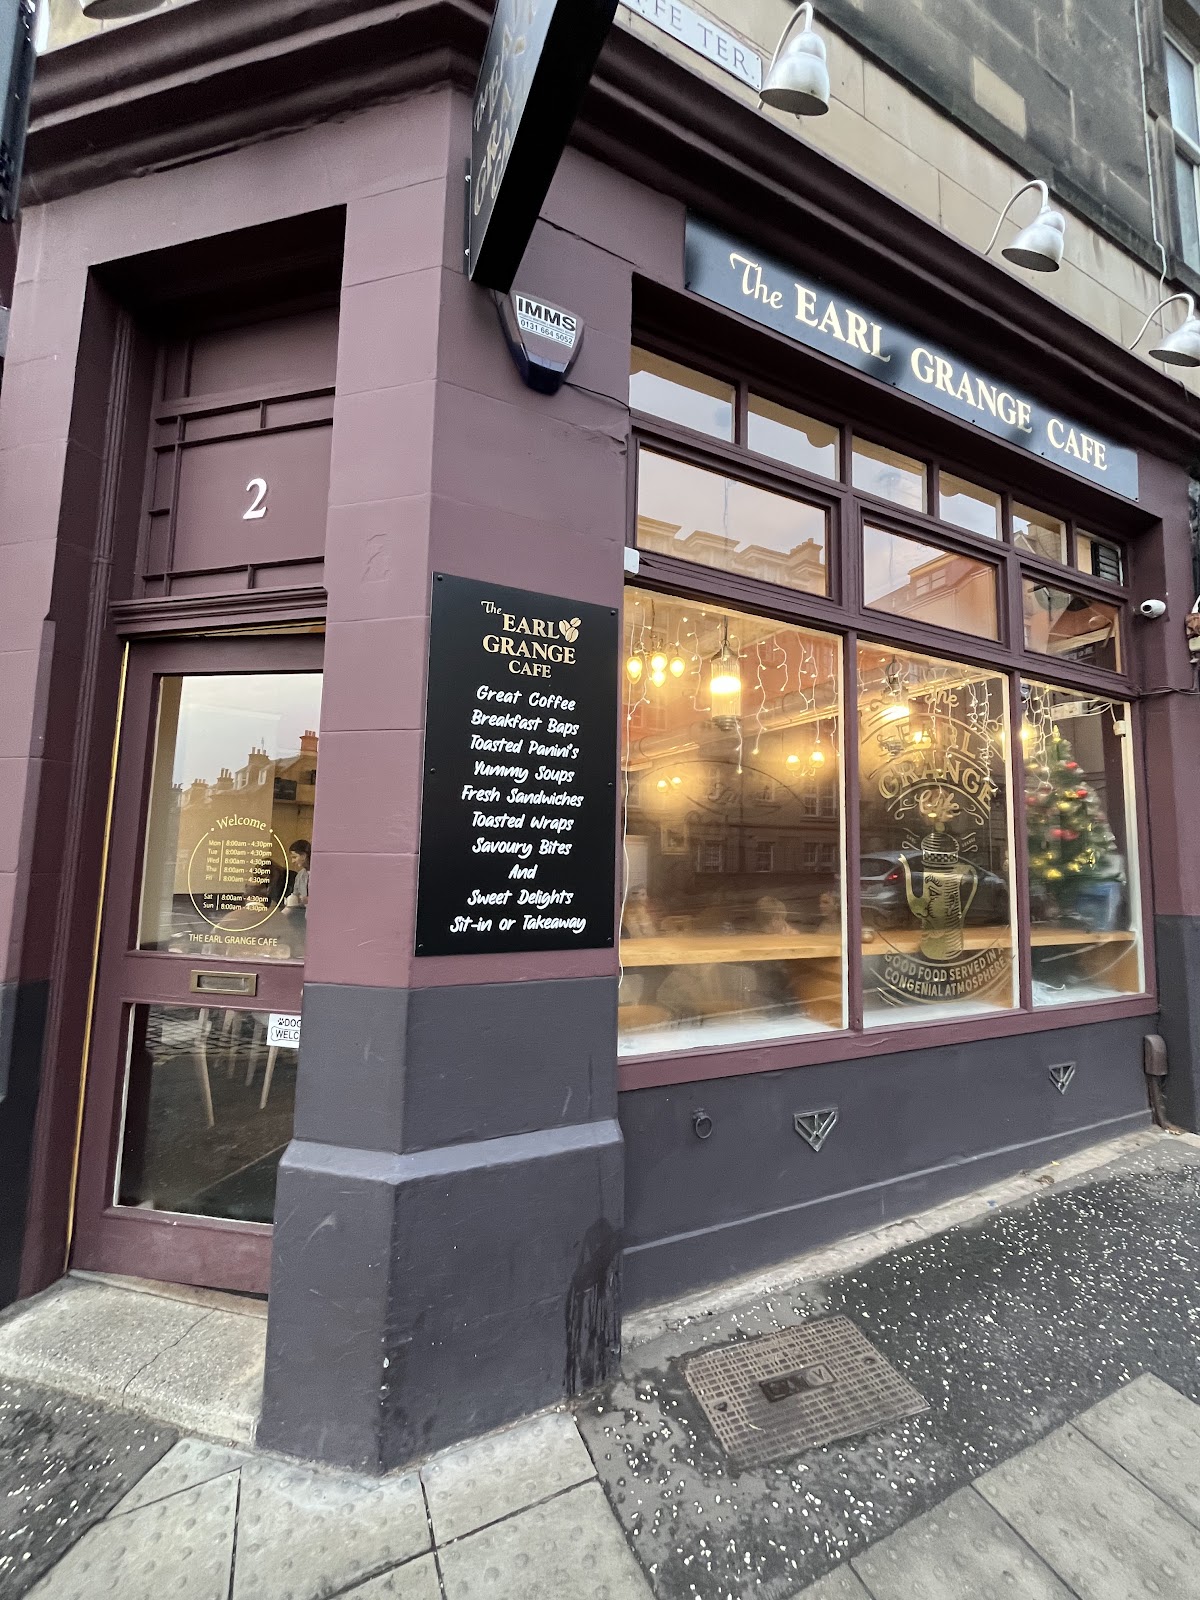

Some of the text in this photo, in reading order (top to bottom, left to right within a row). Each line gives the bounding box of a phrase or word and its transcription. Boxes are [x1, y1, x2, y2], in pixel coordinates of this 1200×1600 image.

[637, 0, 756, 80] FE TER.
[518, 297, 576, 332] IMMS
[520, 319, 538, 331] 0131
[540, 326, 554, 337] 664
[555, 333, 573, 345] 5052
[730, 252, 1108, 472] The EARL GRANGE CAFE
[242, 477, 268, 520] 2
[480, 600, 502, 615] The
[502, 613, 561, 640] EARL
[482, 633, 577, 665] GRANGE
[508, 659, 552, 679] CAFE
[476, 684, 577, 712] Great Coffee
[471, 709, 580, 738] Breakfast Baps
[470, 733, 580, 760] Toasted Panini's
[472, 760, 575, 786] Yummy Soups
[878, 756, 992, 812] GRANGE
[461, 784, 584, 808] Fresh Sandwiches
[215, 813, 268, 832] Welcome
[471, 810, 526, 829] Toasted
[250, 849, 272, 857] 4:30pm
[251, 840, 273, 848] 4:30pm
[471, 837, 573, 860] Savoury Bites
[224, 857, 246, 865] 8:00am
[249, 858, 272, 866] 4:30pm
[248, 867, 271, 875] 4:30pm
[507, 863, 539, 880] And
[222, 875, 244, 883] 8:00am
[247, 876, 270, 885] 4:30pm
[202, 901, 214, 909] Sun
[220, 903, 242, 911] 8:00am
[245, 904, 268, 913] 4:30pm
[221, 894, 243, 902] 8:00am
[246, 895, 269, 903] 4:30pm
[466, 888, 574, 910] Sweet Delights
[449, 914, 587, 934] Sit-in or Takeaway
[188, 933, 278, 947] THE EARL GRANGE CAFE
[884, 949, 917, 976] GOOD
[917, 965, 948, 983] FOOD
[949, 956, 986, 982] SERVED
[985, 948, 997, 965] IN
[884, 955, 1007, 998] CONGENIAL ATMOSPHERE
